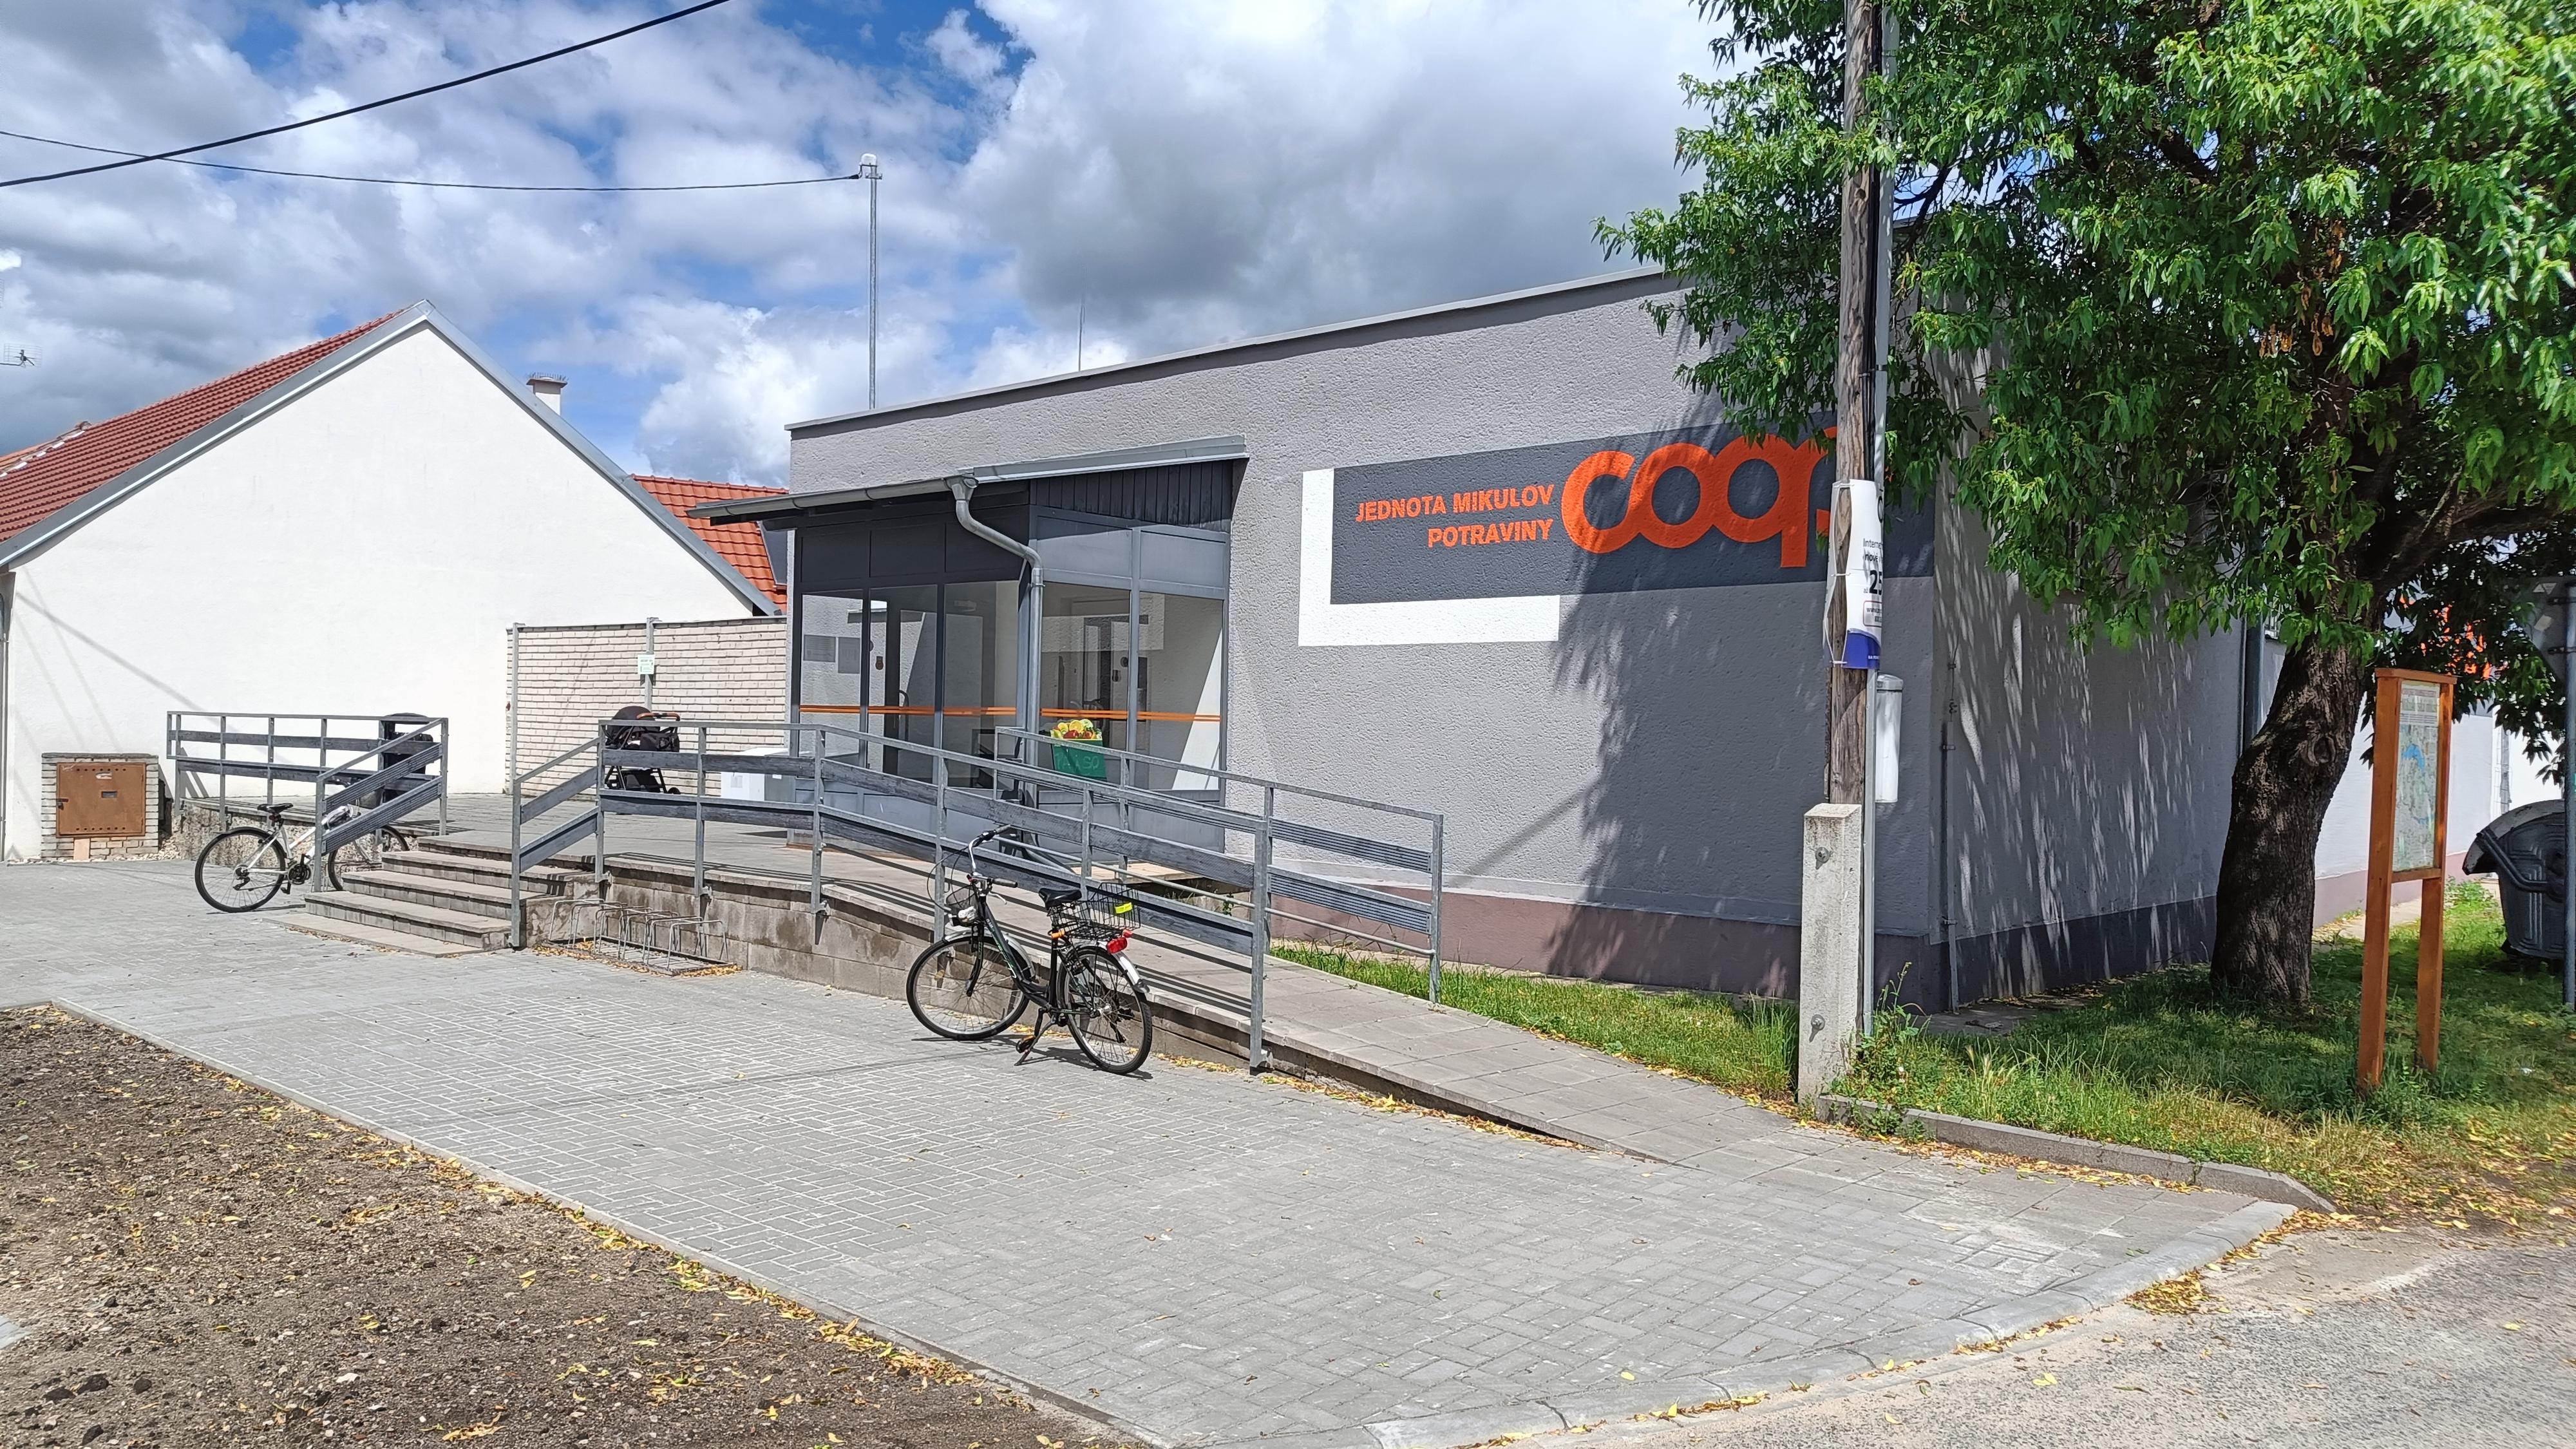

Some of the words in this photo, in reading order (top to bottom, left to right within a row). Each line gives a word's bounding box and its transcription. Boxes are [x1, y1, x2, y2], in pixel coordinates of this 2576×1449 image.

[1355, 495, 1447, 523] JEDNOTA
[1452, 484, 1555, 514] MIKULOV
[1427, 518, 1554, 548] POTRAVINY
